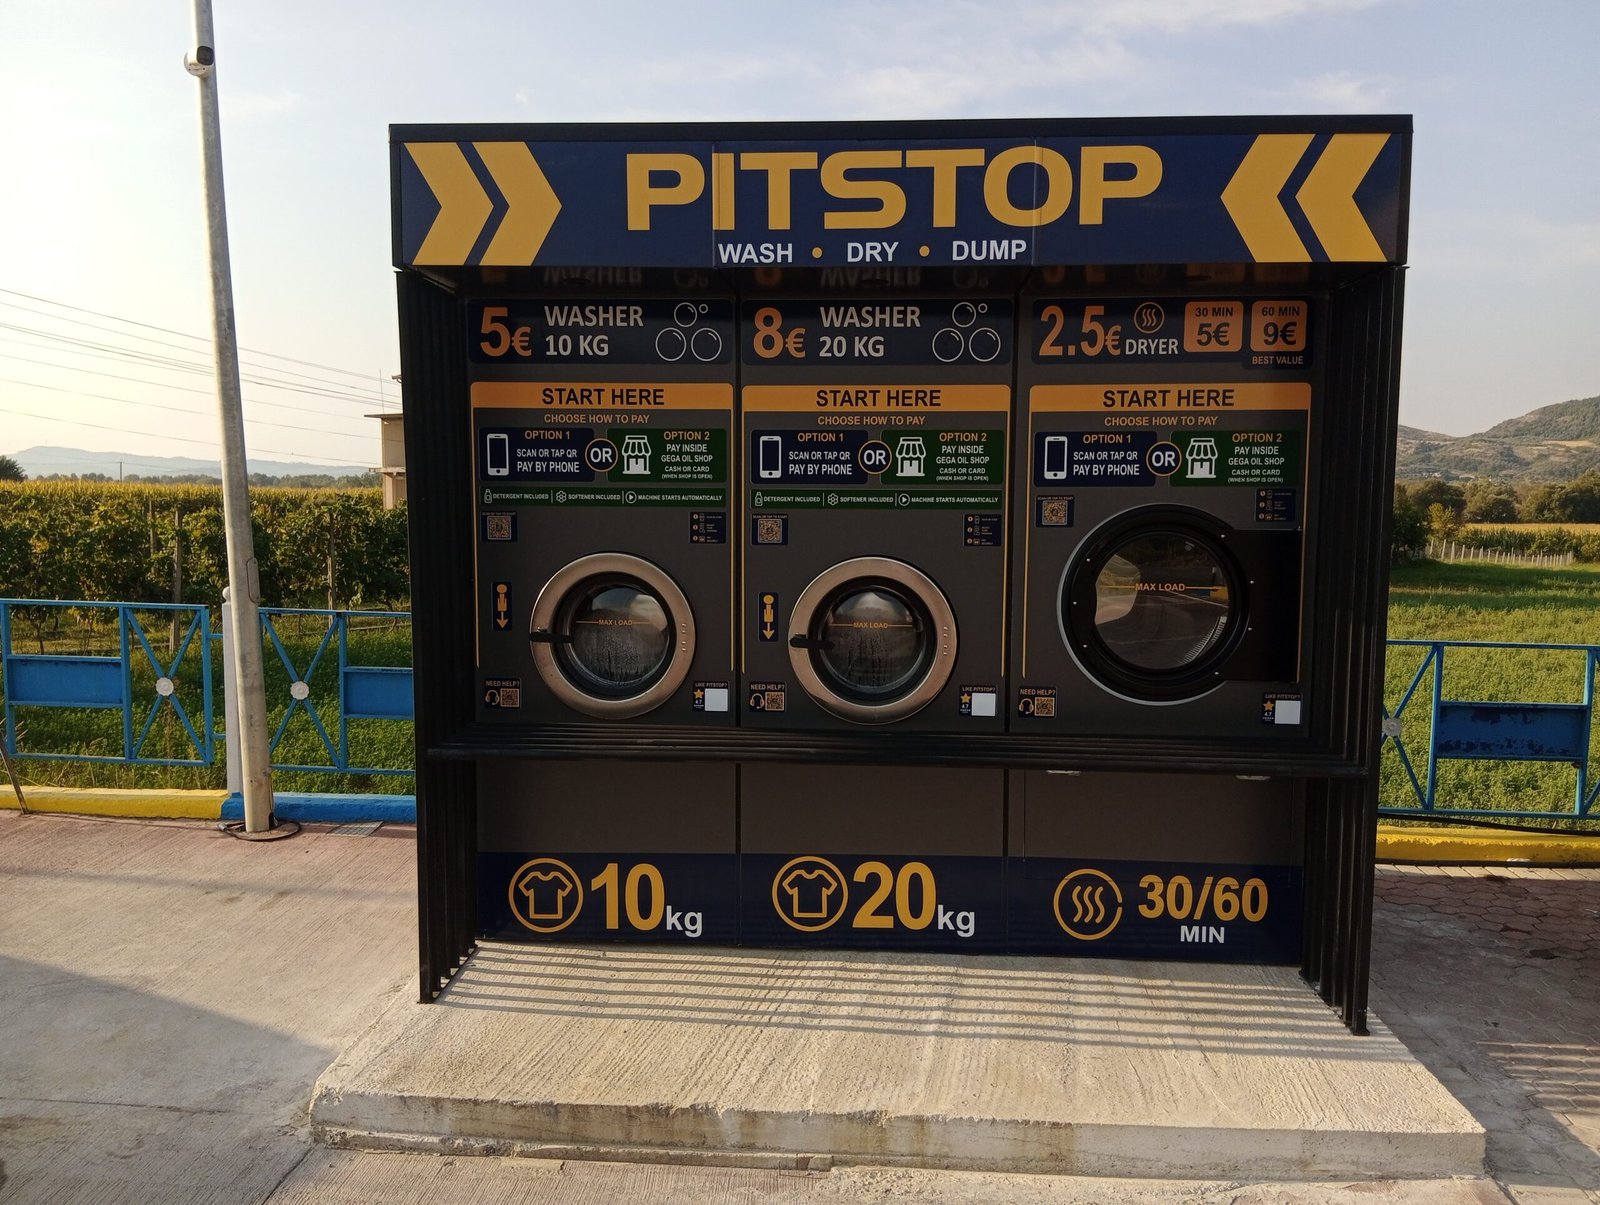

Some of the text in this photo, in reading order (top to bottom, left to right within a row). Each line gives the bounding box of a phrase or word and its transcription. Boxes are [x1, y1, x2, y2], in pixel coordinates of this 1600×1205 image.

[627, 146, 1162, 230] PITSTOP
[718, 240, 1026, 263] WASH DRY DUMP
[545, 306, 643, 326] WASHER
[820, 307, 920, 327] WASHER
[1196, 307, 1233, 318] 30 MIN
[1261, 306, 1300, 317] 60 MIN
[481, 308, 531, 356] 5€
[754, 308, 805, 358] 8€
[1039, 306, 1121, 356] 2.5€
[1197, 322, 1229, 346] 5€
[1263, 322, 1297, 346] 9€
[546, 335, 608, 355] 10 KG
[820, 336, 884, 357] 20 KG
[1126, 339, 1178, 354] DRYER
[1252, 356, 1303, 365] BEST VALUE
[543, 388, 664, 405] START HERE
[817, 390, 941, 406] START HERE
[1103, 390, 1234, 407] START HERE
[544, 414, 649, 424] CHOOSE HOW TO PAY
[818, 416, 925, 425] CHOOSE HOW TO PAY
[1104, 416, 1218, 426] CHOOSE HOW TO PAY
[525, 430, 570, 440] OPTION 1
[663, 431, 710, 440] OPTION 2
[797, 432, 843, 442] OPTION 1
[939, 432, 987, 442] OPTION 2
[1083, 434, 1131, 444] OPTION 1
[1232, 433, 1282, 443] OPTION 2
[517, 448, 577, 458] SCAN OR TAP QR
[666, 444, 707, 452] PAY INSIDE
[942, 445, 984, 454] PAY INSIDE
[1234, 446, 1279, 455] PAY INSIDE
[589, 448, 612, 464] OR
[661, 454, 681, 462] GEGA
[694, 454, 713, 462] SHOP
[789, 451, 850, 460] SCAN OR TAP QR
[862, 450, 886, 466] OR
[1073, 451, 1138, 460] SCAN OR TAP QR
[1150, 450, 1176, 467] OR
[517, 461, 579, 472] PAY BY PHONE
[1228, 457, 1285, 466] GEGA OIL SHOP
[789, 464, 852, 474] PAY BY PHONE
[1074, 464, 1139, 475] PAY BY PHONE
[1134, 583, 1185, 592] MAX LOAD
[502, 679, 521, 688] HELP?
[1036, 688, 1056, 696] HELP?
[592, 864, 702, 937] 10kg
[854, 862, 974, 937] 20kg
[1139, 875, 1268, 921] 30/60
[1181, 926, 1224, 943] MIN
